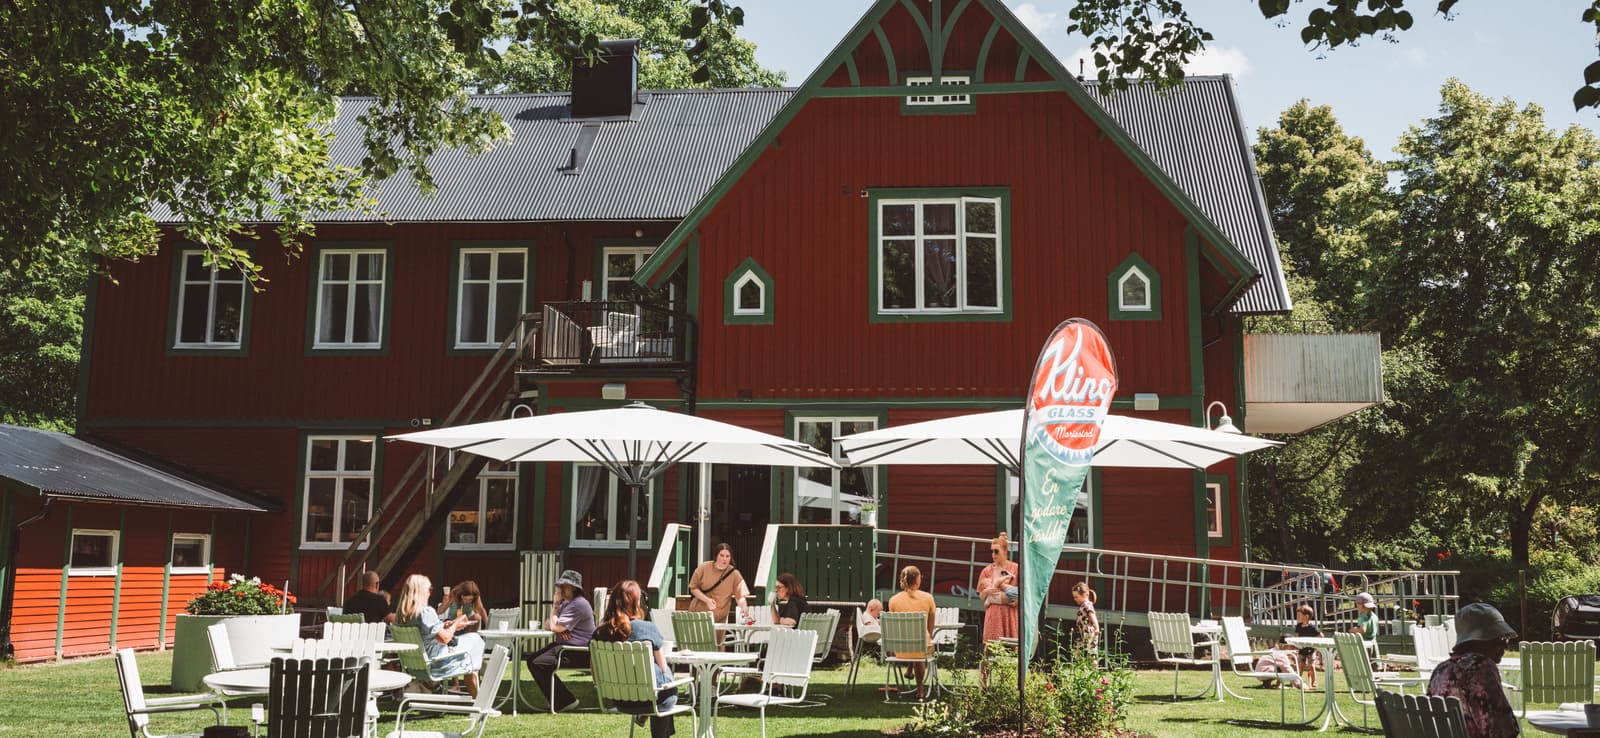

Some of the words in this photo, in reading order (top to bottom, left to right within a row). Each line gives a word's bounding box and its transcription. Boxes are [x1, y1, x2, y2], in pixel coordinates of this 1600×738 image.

[1040, 326, 1111, 405] Kling
[1047, 407, 1096, 418] GLASS
[1042, 467, 1060, 495] En
